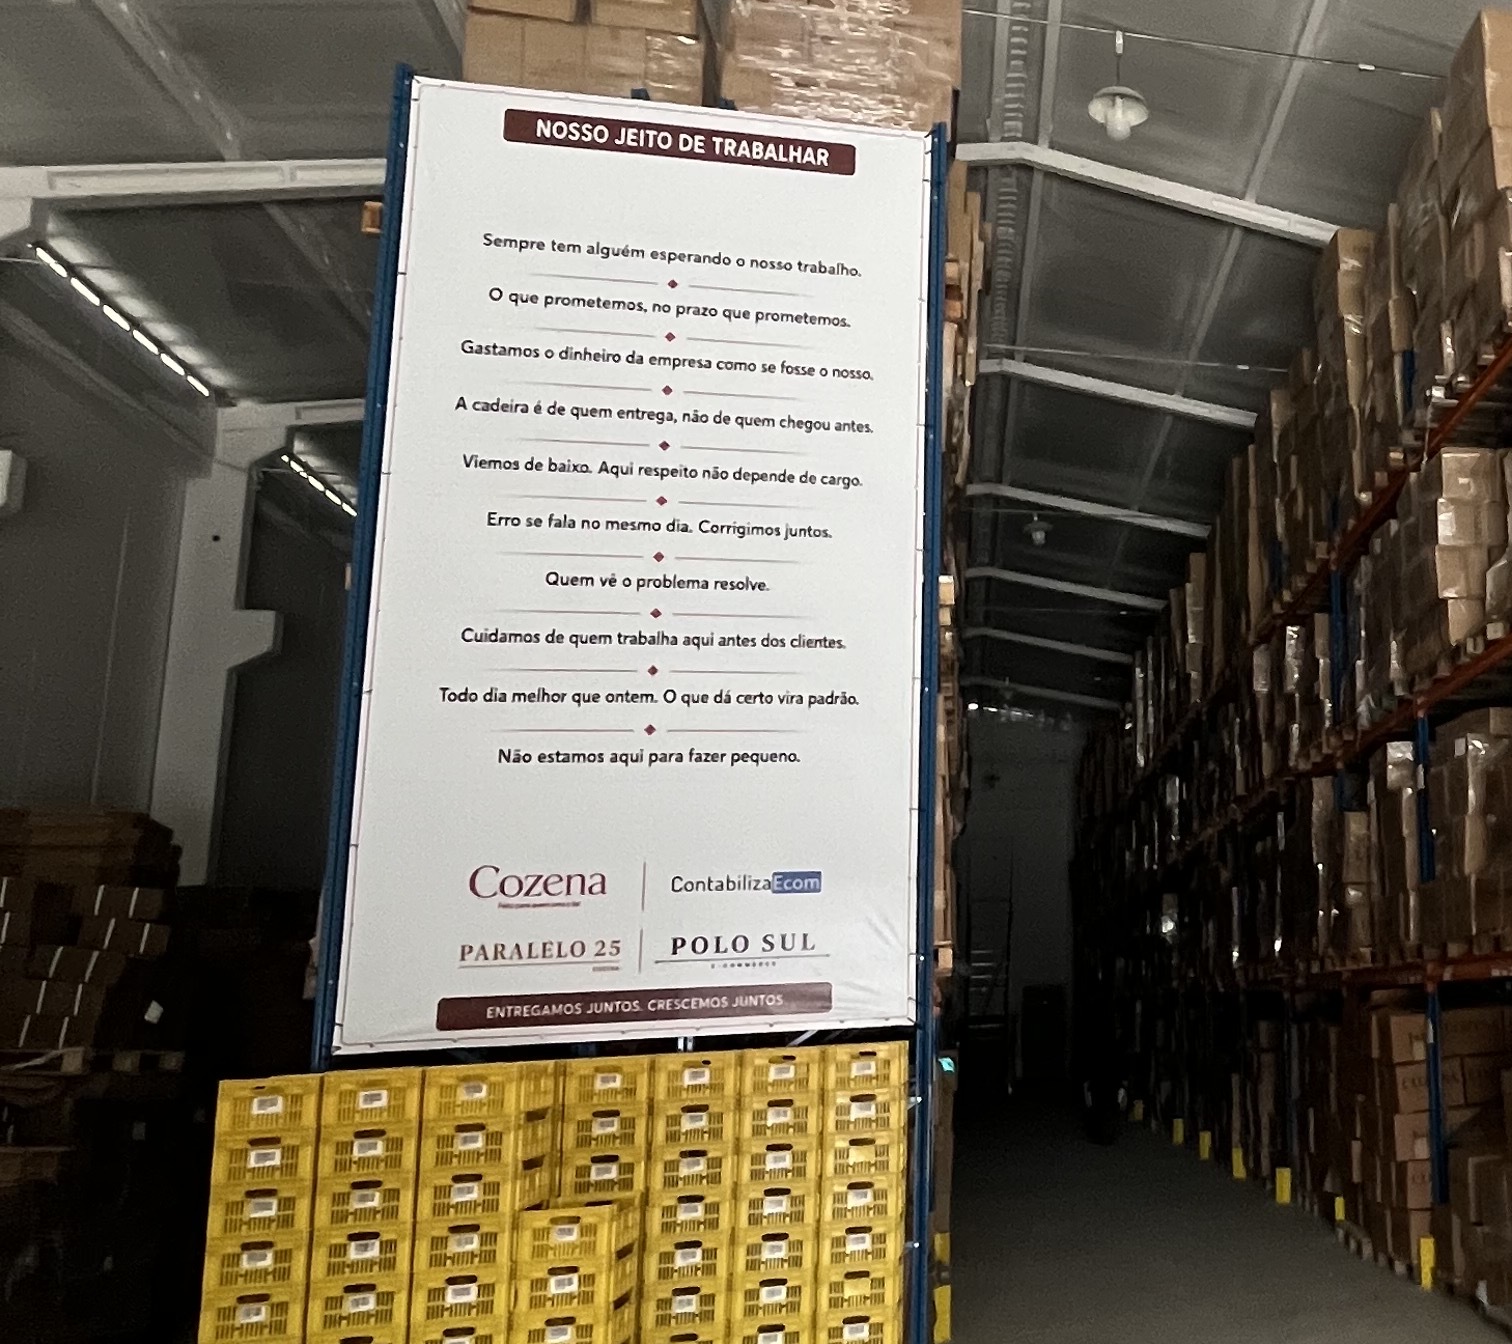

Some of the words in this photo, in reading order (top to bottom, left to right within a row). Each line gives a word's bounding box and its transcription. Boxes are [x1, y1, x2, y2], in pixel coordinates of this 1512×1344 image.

[536, 118, 609, 144] NOSSO
[614, 127, 673, 150] JEITO
[678, 133, 706, 154] DE
[711, 136, 830, 167] TRABALHAR
[482, 232, 546, 254] Sempre
[550, 238, 582, 254] tem
[585, 240, 646, 260] alguém
[649, 250, 732, 267] esperando
[735, 257, 746, 268] o
[749, 258, 794, 272] nosso
[796, 259, 862, 278] trabalho.
[488, 286, 504, 302] O
[508, 292, 540, 308] que
[543, 294, 648, 314] prometemos,
[651, 302, 672, 314] no
[675, 304, 719, 319] prazo
[721, 308, 751, 323] que
[754, 310, 852, 328] prometemos.
[460, 339, 541, 359] Gastamos
[543, 348, 556, 360] o
[558, 345, 622, 364] dinheiro
[624, 349, 645, 365] da
[648, 355, 713, 372] empresa
[715, 360, 757, 373] como
[760, 362, 777, 374] se
[780, 359, 816, 377] fosse
[818, 367, 829, 378] o
[831, 368, 875, 382] nosso.
[453, 395, 469, 412] A
[471, 396, 530, 414] cadeira
[532, 399, 543, 415] é
[546, 399, 567, 417] de
[569, 405, 613, 421] quem
[616, 406, 678, 426] entrega,
[681, 408, 710, 424] não
[712, 409, 732, 426] de
[734, 415, 776, 430] quem
[778, 414, 831, 434] chegou
[834, 419, 874, 434] antes.
[462, 453, 521, 473] Viemos
[523, 455, 544, 472] de
[547, 456, 594, 475] baixo.
[596, 460, 635, 480] Aqui
[637, 463, 699, 482] respeito
[701, 465, 730, 481] não
[732, 466, 796, 486] depende
[798, 470, 817, 485] de
[819, 475, 864, 491] cargo.
[486, 511, 522, 528] Erro
[525, 516, 544, 528] se
[547, 512, 577, 530] fala
[580, 518, 601, 531] no
[604, 519, 662, 532] mesmo
[665, 517, 694, 534] dia.
[698, 519, 782, 540] Corrigimos
[783, 522, 833, 541] juntos.
[544, 570, 595, 588] Quem
[599, 572, 618, 588] vê
[621, 576, 633, 588] o
[636, 573, 710, 593] problema
[713, 575, 771, 592] resolve.
[460, 626, 541, 644] Cuidamos
[544, 627, 565, 645] de
[568, 633, 613, 649] quem
[616, 629, 679, 647] trabalha
[682, 631, 715, 652] aqui
[717, 633, 757, 648] antes
[760, 632, 787, 648] dos
[789, 633, 847, 650] clientes.
[438, 686, 479, 704] Todo
[482, 686, 508, 703] dia
[510, 686, 568, 704] melhor
[570, 692, 602, 709] que
[604, 689, 659, 704] ontem.
[662, 688, 678, 705] O
[680, 693, 710, 709] que
[712, 688, 732, 705] dá
[735, 691, 774, 705] certo
[777, 690, 804, 705] vira
[807, 689, 861, 711] padrão.
[497, 748, 533, 764] Não
[536, 749, 605, 764] estamos
[609, 748, 645, 768] aqui
[647, 752, 684, 769] para
[688, 747, 728, 764] fazer
[730, 752, 802, 768] pequeno.
[469, 864, 607, 899] Cozena
[460, 940, 587, 962] PARALELO
[594, 939, 622, 958] 25
[671, 934, 750, 956] POLO
[761, 932, 816, 953] SUL
[486, 1002, 583, 1020] ENTREGAMOS
[647, 996, 729, 1013] CRESCEMOS
